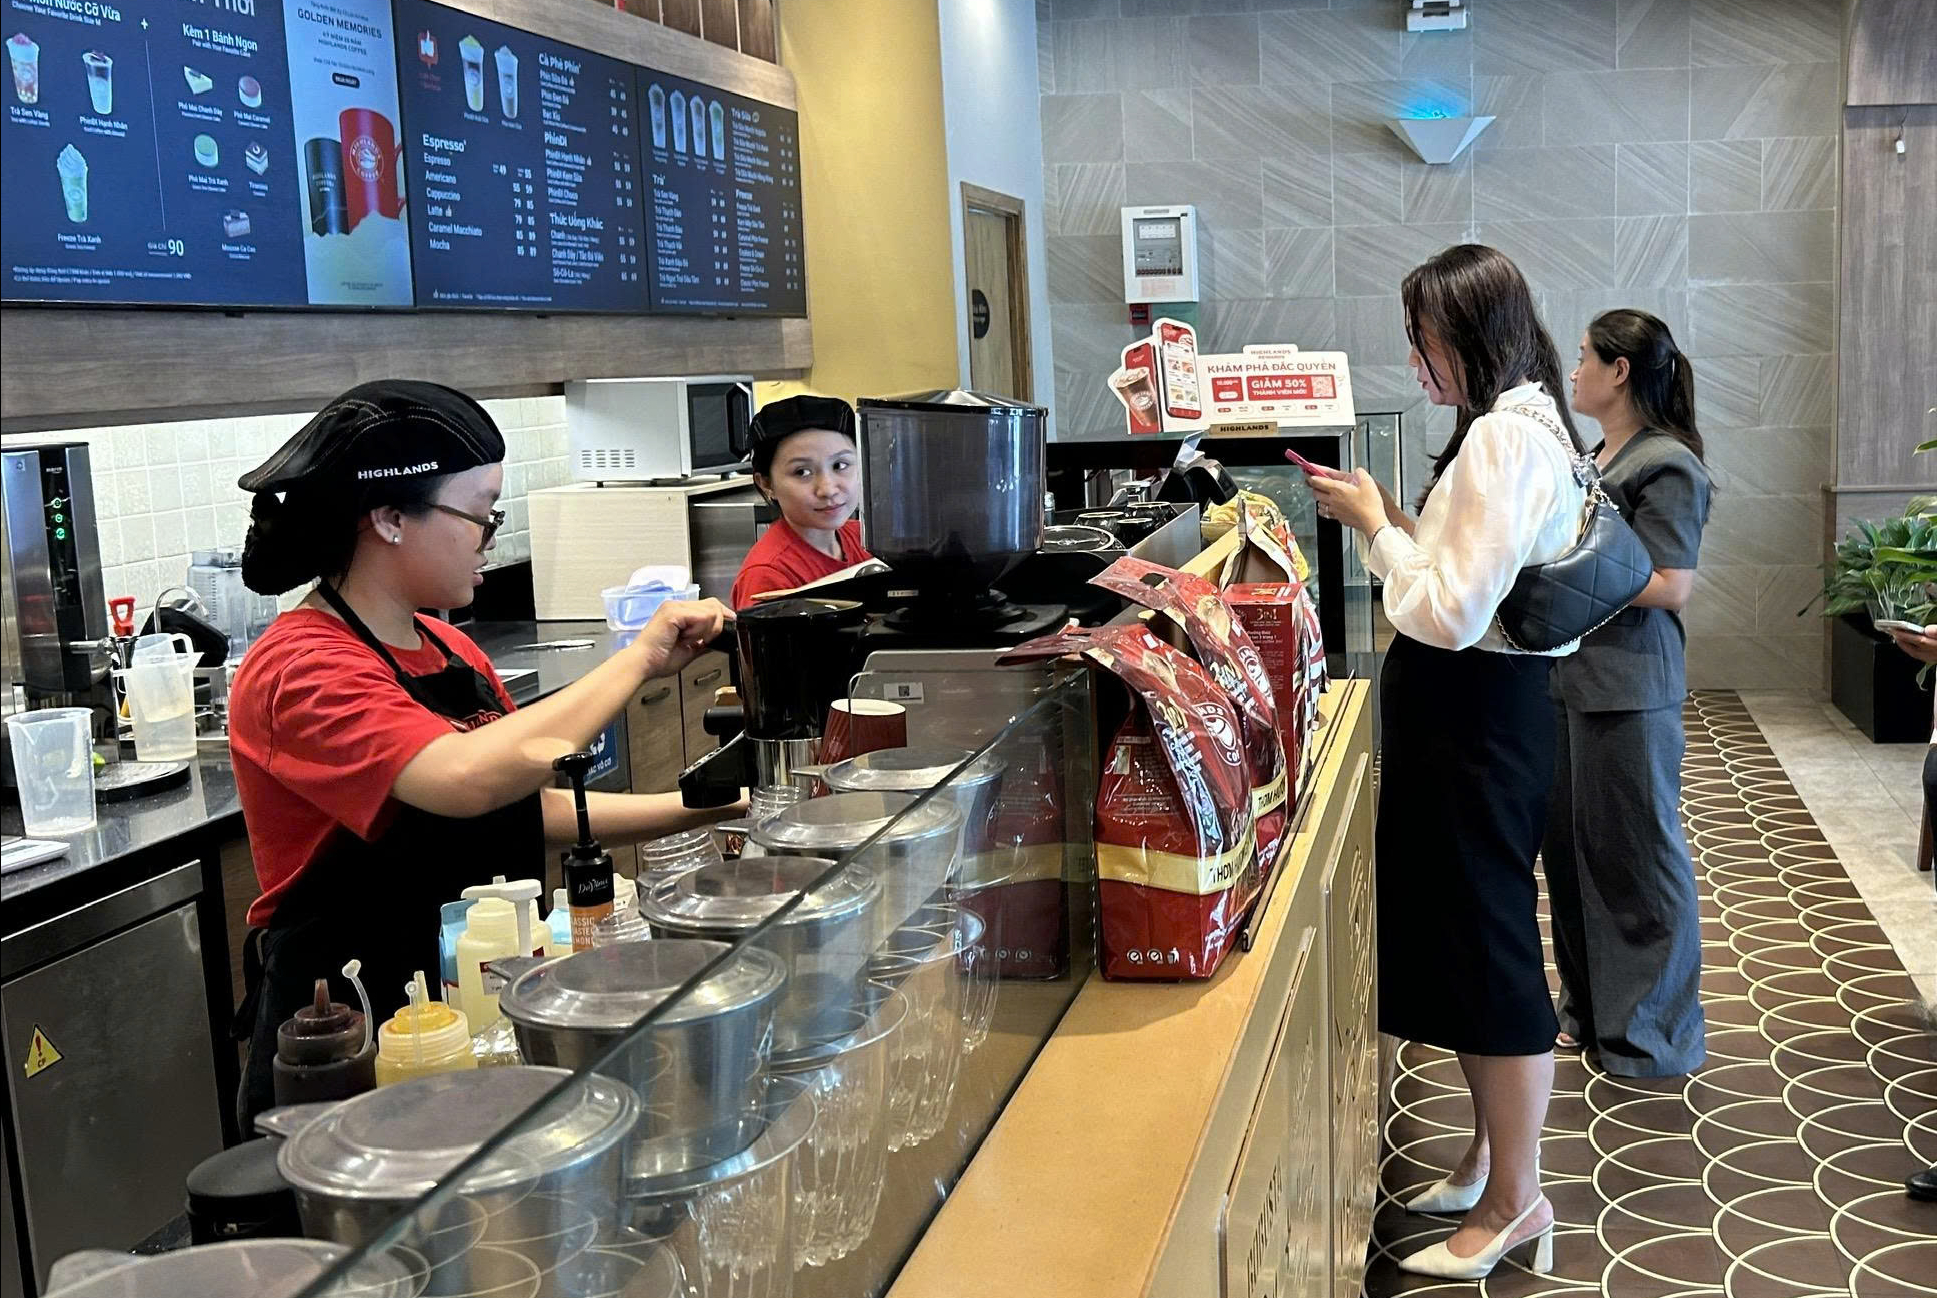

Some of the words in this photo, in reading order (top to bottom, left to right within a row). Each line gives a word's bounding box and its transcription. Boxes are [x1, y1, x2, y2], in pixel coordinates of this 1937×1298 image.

[100, 4, 121, 21] Vừa
[297, 8, 335, 27] GOLDEN
[336, 18, 382, 39] MEMORIES
[182, 22, 203, 39] Kèm
[204, 29, 210, 41] 1
[212, 29, 234, 46] Bánh
[235, 34, 258, 52] Ngon
[424, 152, 451, 167] Espresso
[425, 170, 457, 185] Americano
[426, 187, 461, 202] Cappuccino
[427, 204, 443, 217] Latte
[428, 221, 453, 235] Caramel
[453, 224, 482, 237] Macchiato
[168, 239, 184, 257] 90
[429, 239, 450, 251] Mocha
[1207, 362, 1243, 374] KHÁM
[1246, 361, 1269, 371] PHÁ
[1251, 377, 1282, 389] GIẢM
[1285, 379, 1307, 388] 50%
[1220, 424, 1269, 432] HIGHLANDS
[358, 461, 439, 479] HIGHLANDS
